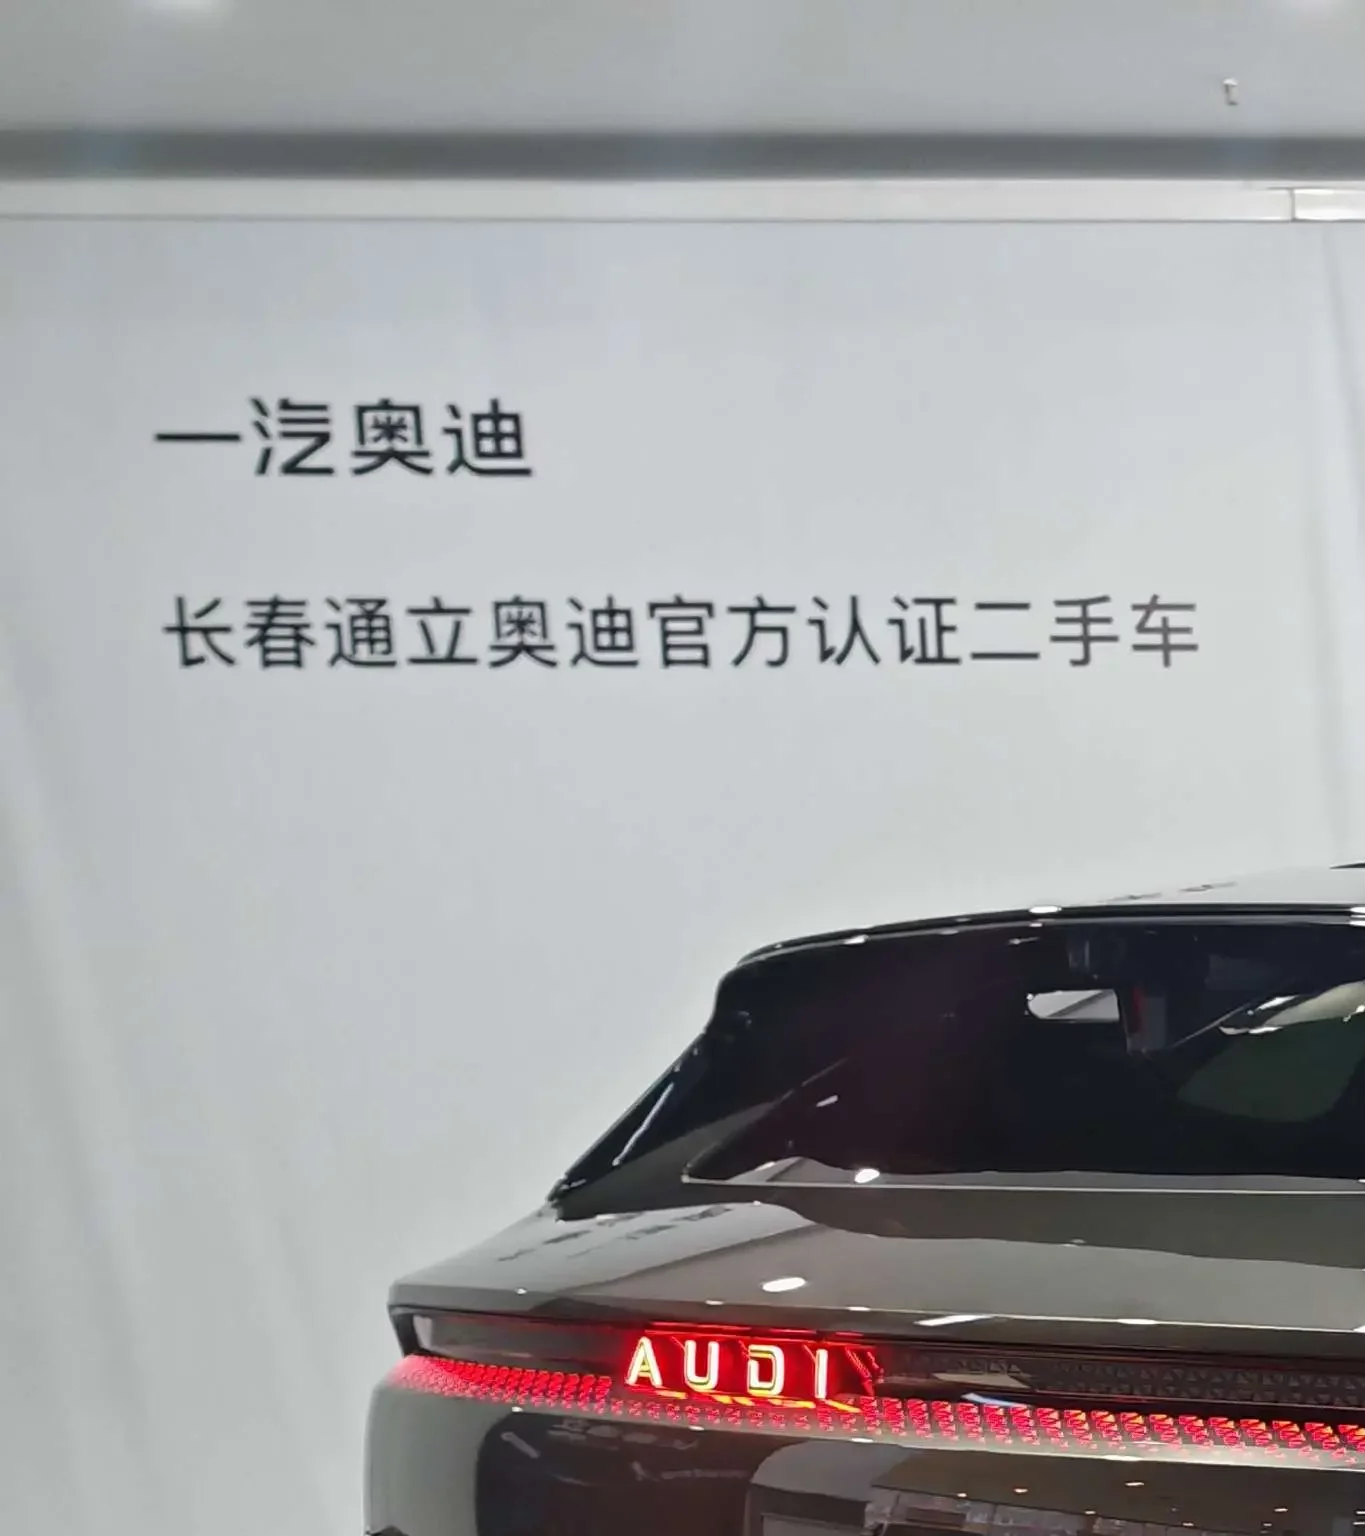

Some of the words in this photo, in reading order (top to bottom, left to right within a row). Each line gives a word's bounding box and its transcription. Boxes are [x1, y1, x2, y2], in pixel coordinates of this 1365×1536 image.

[153, 396, 535, 478] 一汽奥迪
[162, 592, 1200, 670] 长春通立奥迪官方认证二手车
[625, 1335, 829, 1400] AUDI
